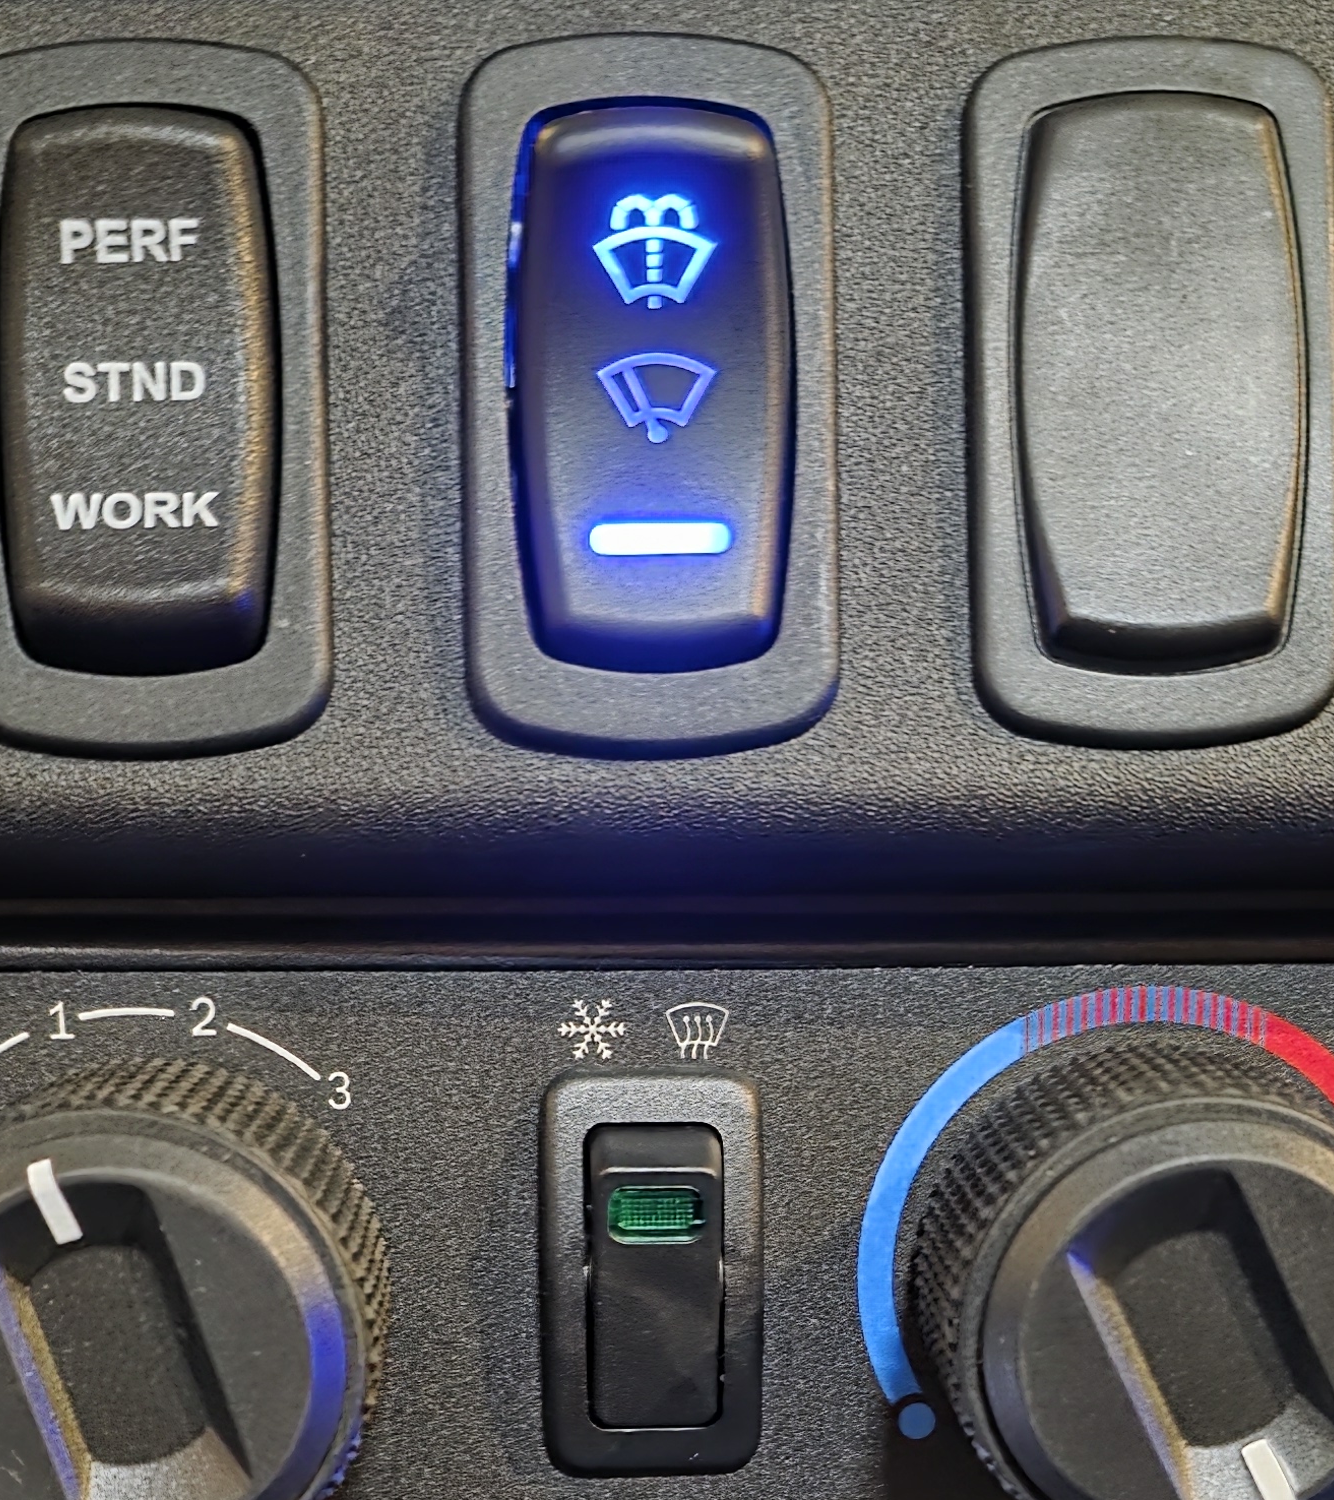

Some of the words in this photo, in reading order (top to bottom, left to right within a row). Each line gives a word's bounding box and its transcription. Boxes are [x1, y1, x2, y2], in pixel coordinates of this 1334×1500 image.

[59, 217, 201, 265] PERF
[63, 361, 206, 404] STND
[49, 491, 220, 531] WORK
[49, 1001, 75, 1041] 1
[189, 997, 218, 1037] 2
[327, 1071, 353, 1110] 3
